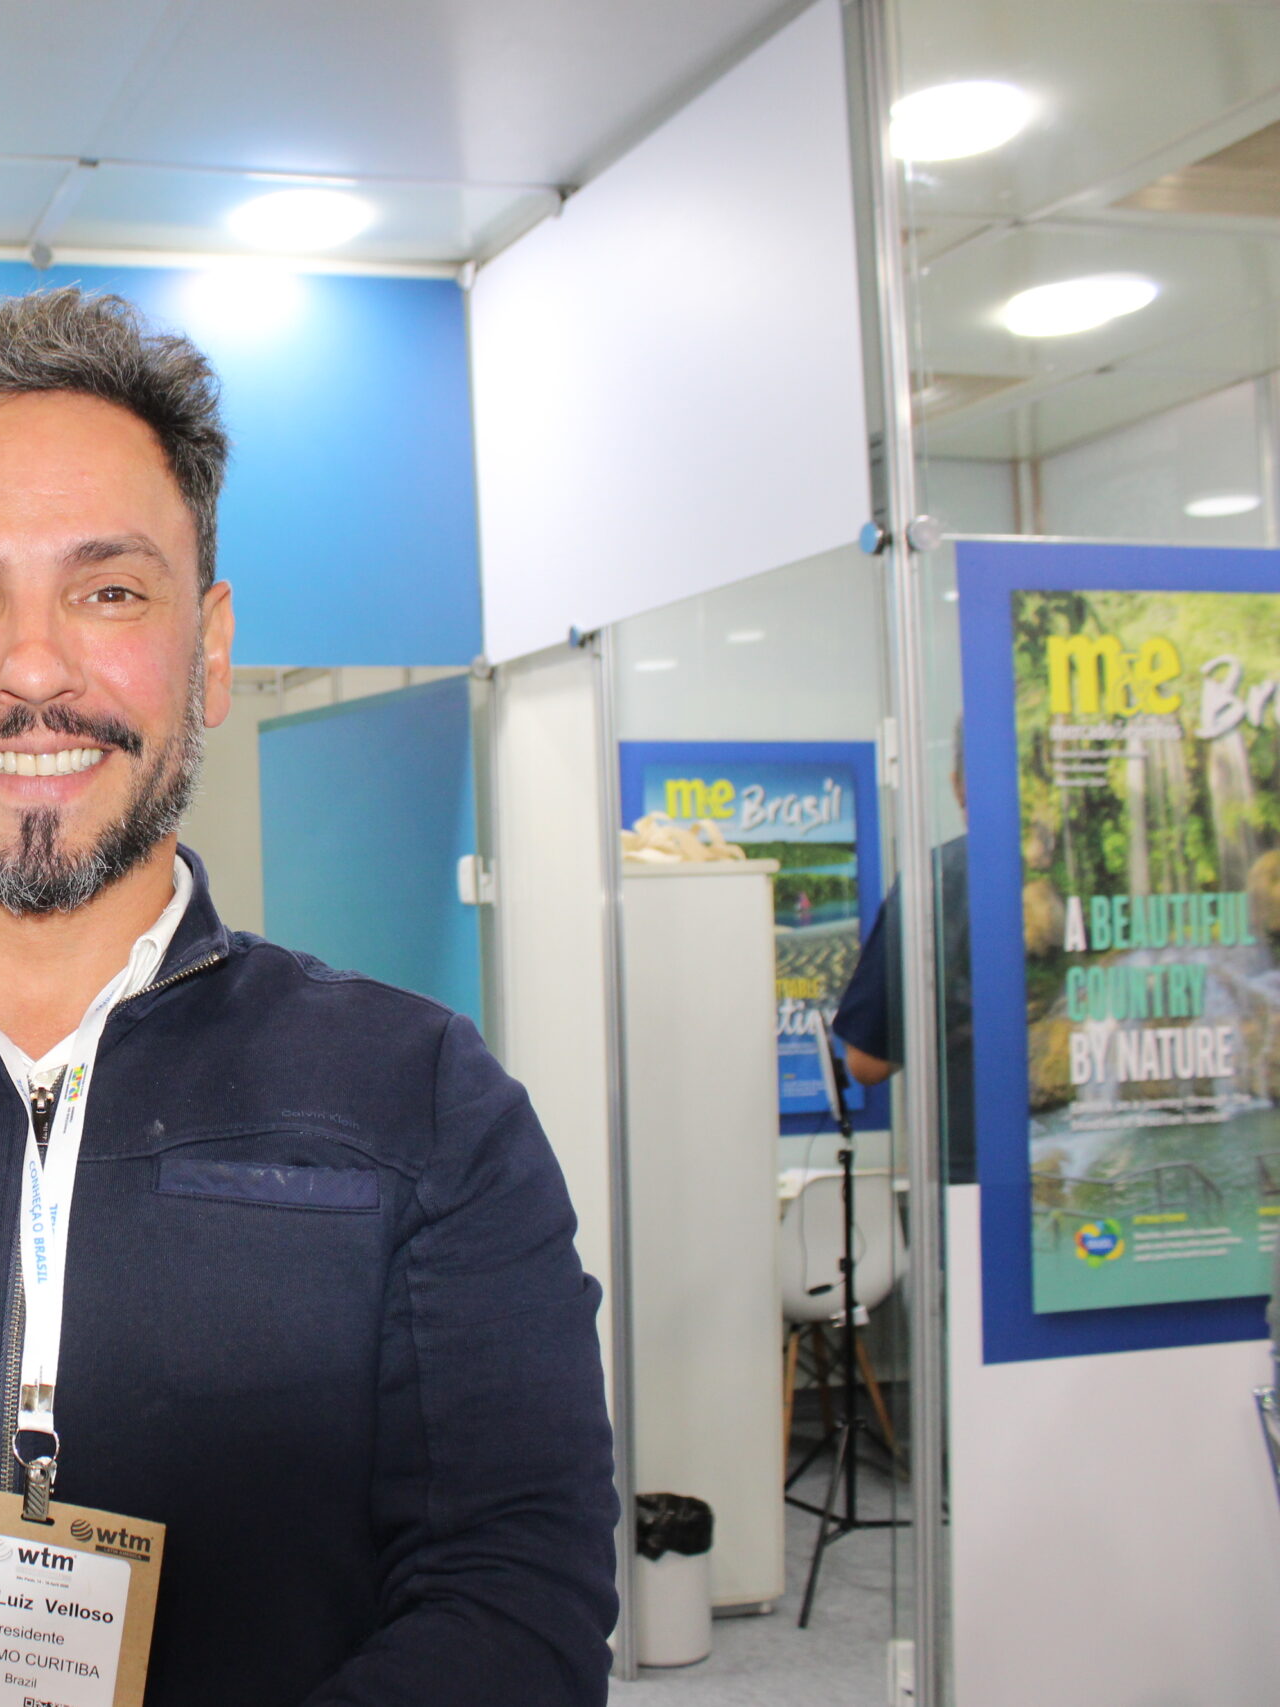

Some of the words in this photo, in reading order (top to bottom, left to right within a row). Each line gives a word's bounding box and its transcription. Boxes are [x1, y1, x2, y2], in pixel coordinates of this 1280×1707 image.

[1046, 634, 1181, 717] m&e
[1195, 655, 1280, 739] Br
[740, 777, 843, 835] Brasil
[1064, 895, 1086, 952] A
[1090, 891, 1257, 951] BEAUTIFUL
[1066, 963, 1208, 1022] COUNTRY
[1070, 1029, 1108, 1085] BY
[1116, 1025, 1235, 1082] NATURE
[28, 1160, 43, 1221] CONHEÇA
[33, 1236, 49, 1284] BRASIL
[17, 1547, 74, 1572] wtm
[96, 1527, 151, 1552] wtm
[45, 1597, 114, 1624] Velloso
[4, 1672, 37, 1689] Brazil
[25, 1651, 100, 1679] CURITIBA
